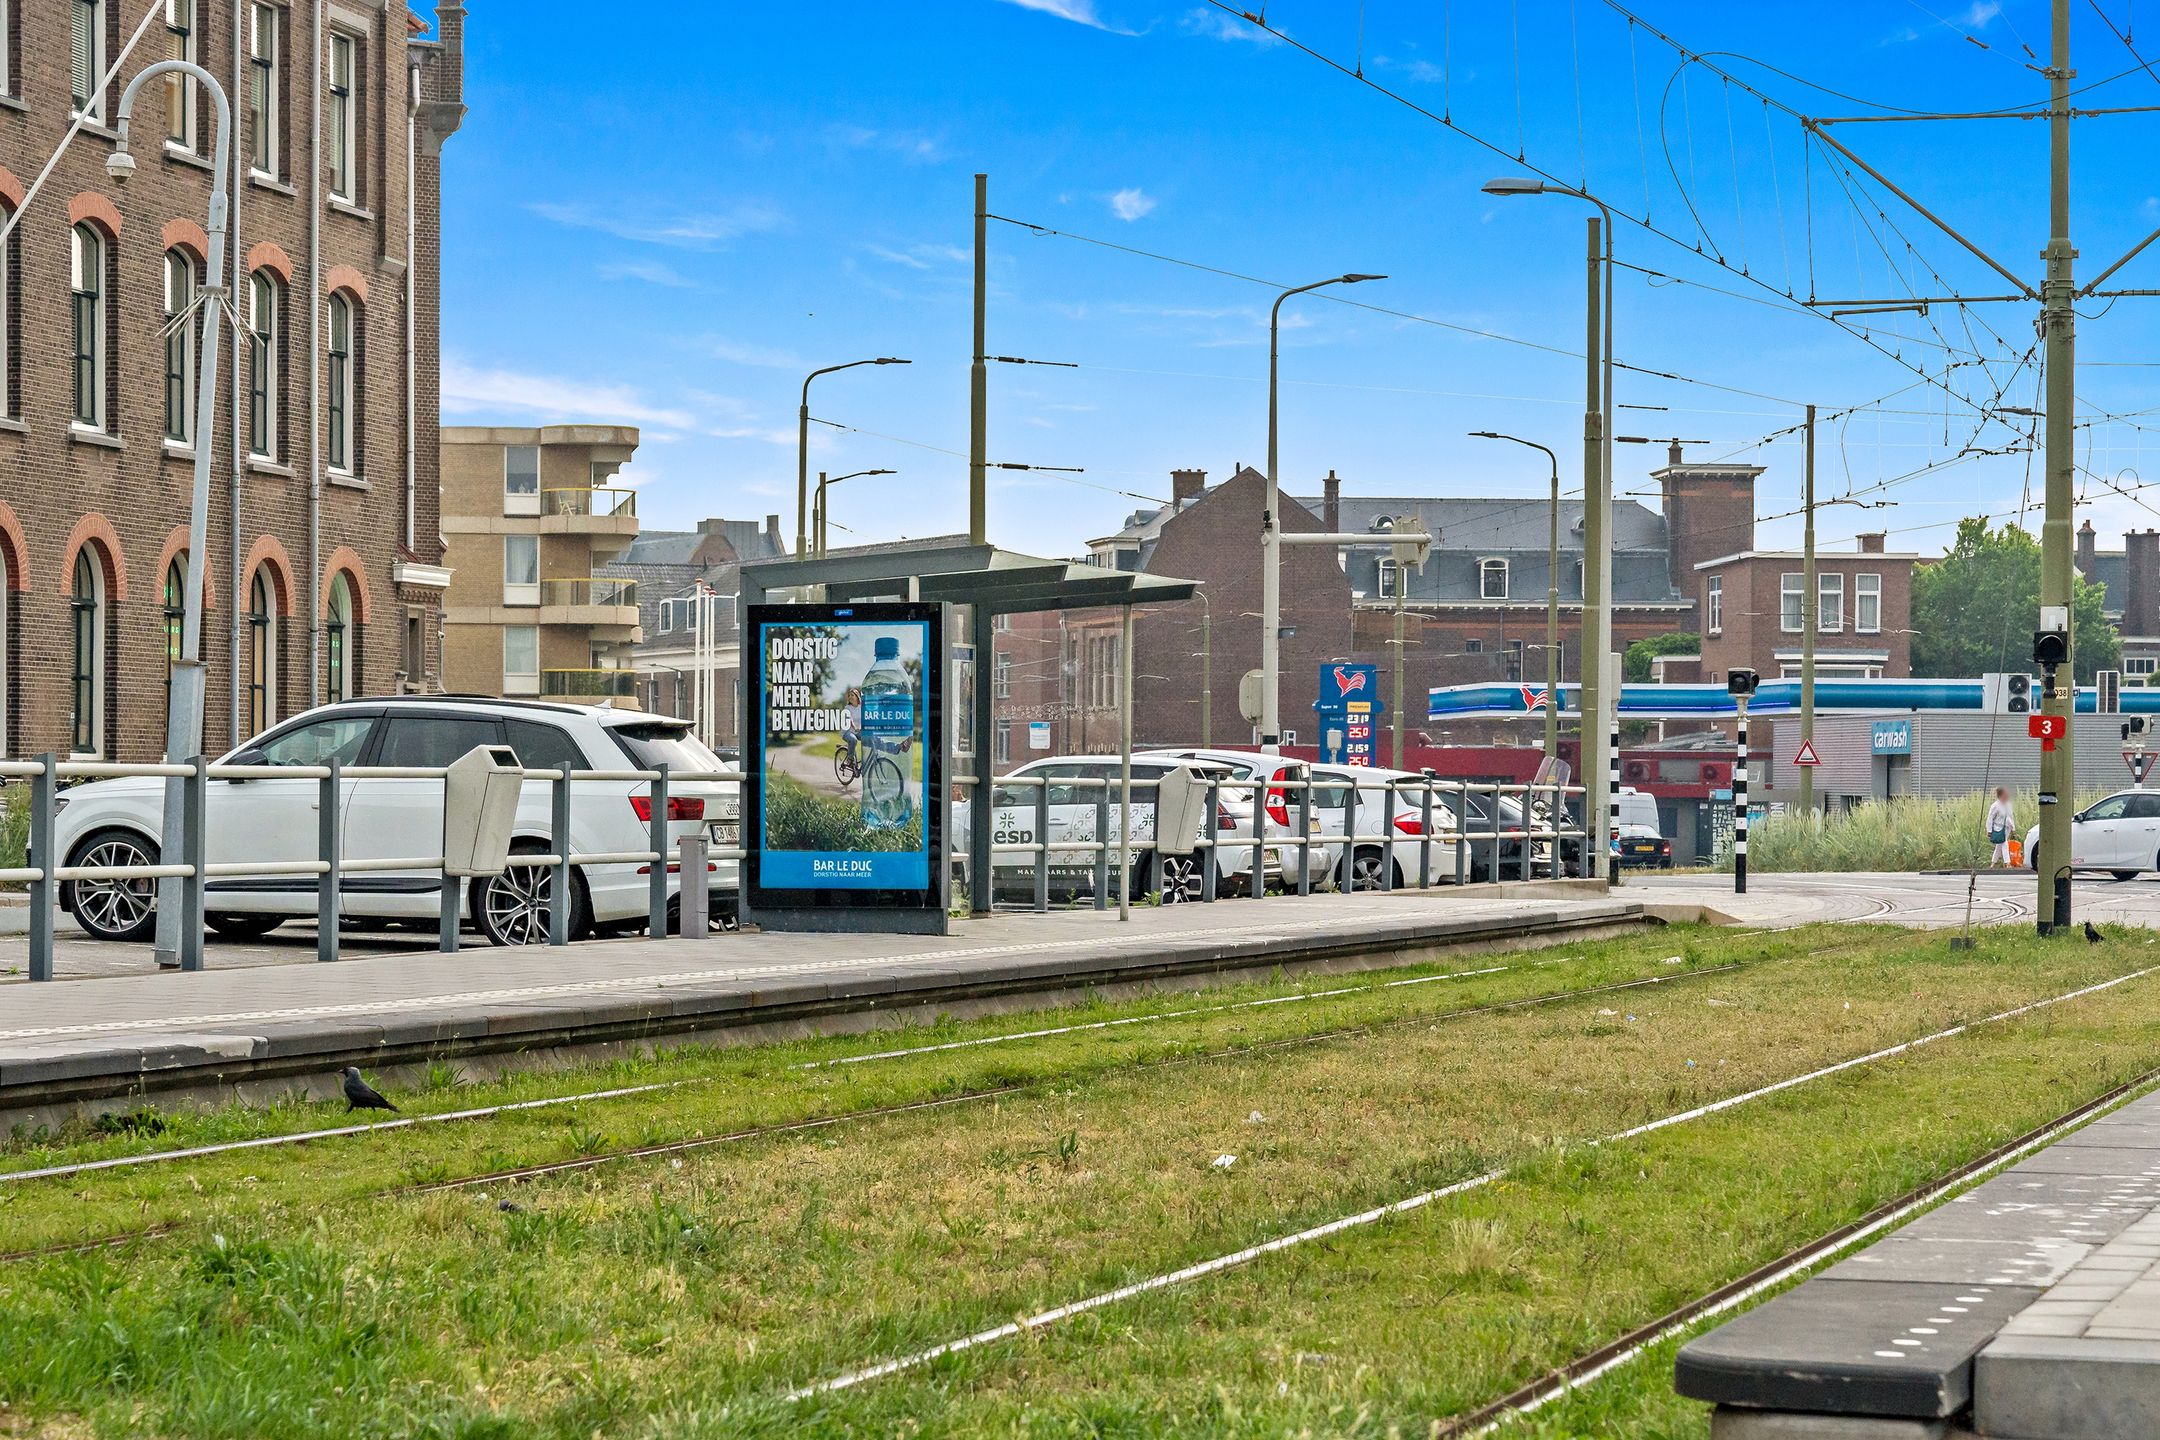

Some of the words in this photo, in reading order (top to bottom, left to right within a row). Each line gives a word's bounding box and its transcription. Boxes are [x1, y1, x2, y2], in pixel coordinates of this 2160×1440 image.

[772, 638, 838, 660] DORSTIG
[772, 662, 814, 684] NAAR
[772, 685, 811, 707] MEER
[772, 709, 851, 731] BEWEGING
[2041, 720, 2052, 735] 3
[1874, 725, 1907, 748] carwash
